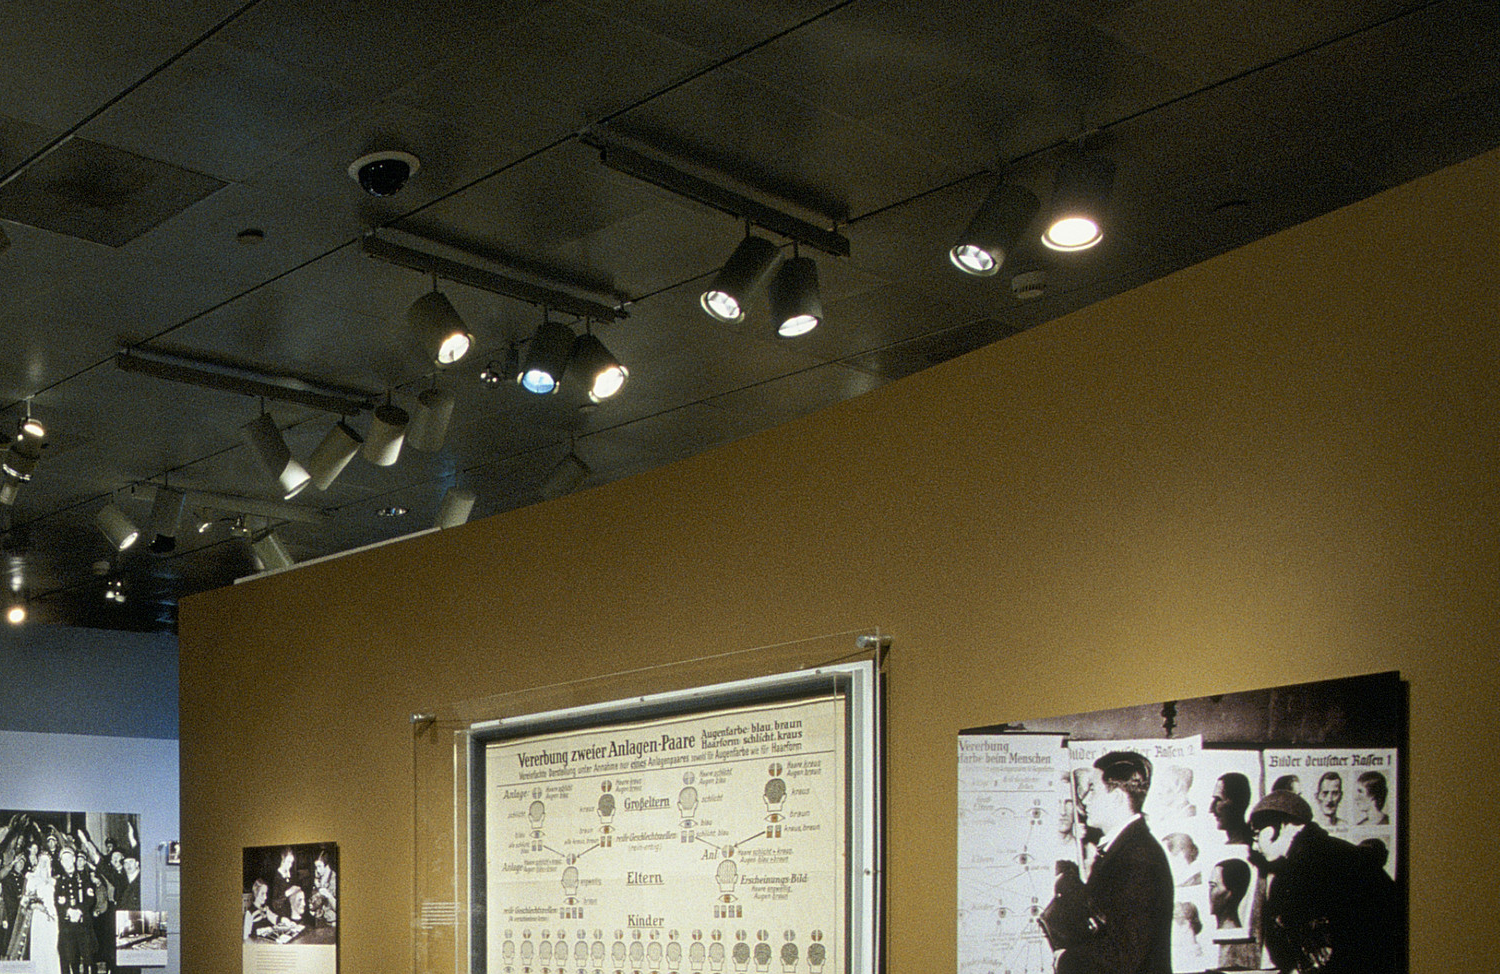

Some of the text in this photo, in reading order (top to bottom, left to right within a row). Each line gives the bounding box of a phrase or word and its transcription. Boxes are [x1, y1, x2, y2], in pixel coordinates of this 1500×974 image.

[774, 720, 802, 730] braun
[777, 730, 802, 740] kraus
[518, 735, 696, 768] Vererbung zweier Anlagen-Paare
[959, 740, 1010, 753] Vererbung
[1009, 752, 1051, 764] Menschen
[624, 796, 670, 811] Großeltern
[627, 871, 663, 884] Eltern
[628, 914, 664, 926] Kinder
